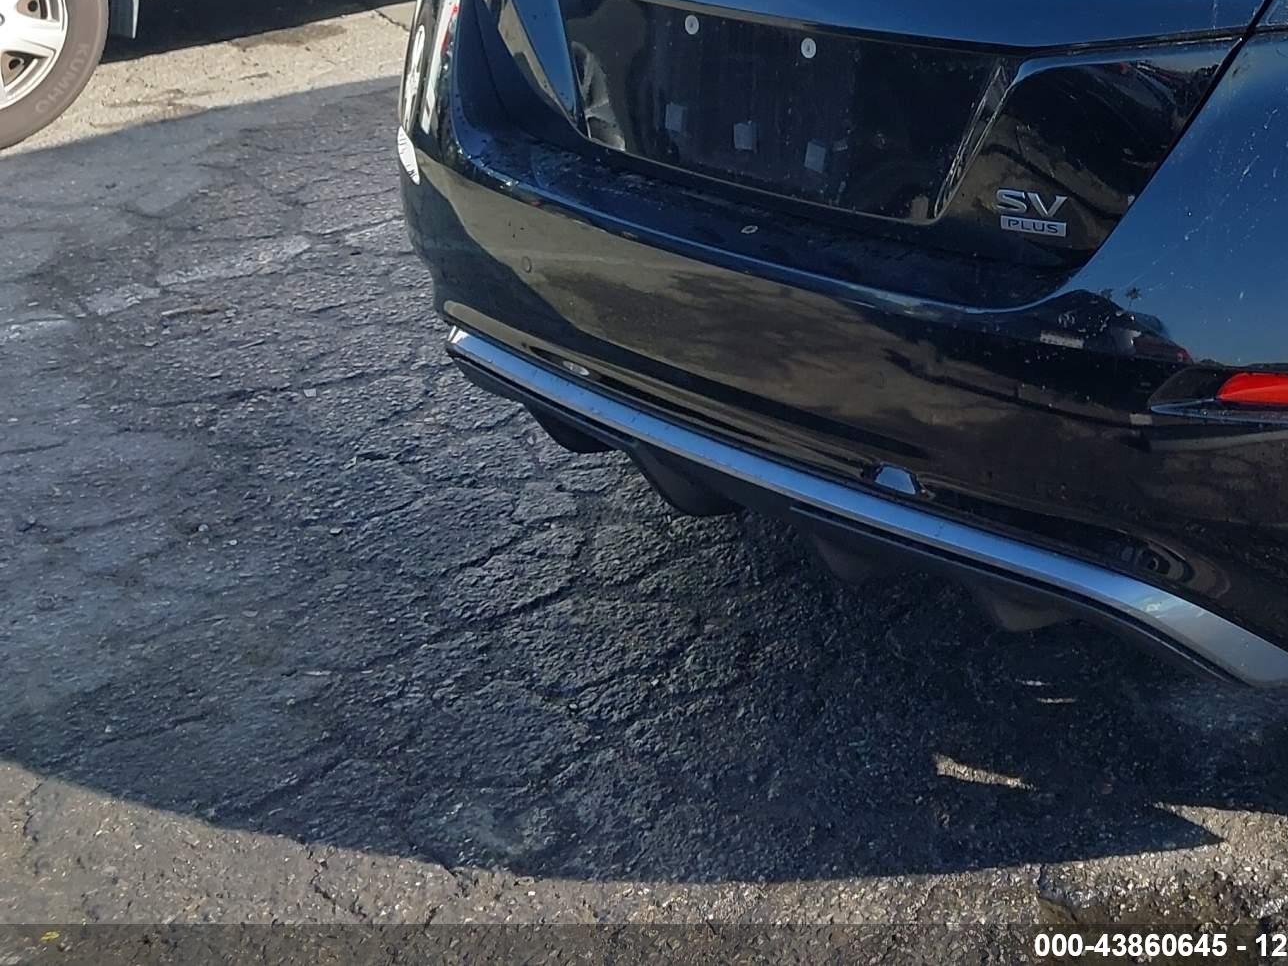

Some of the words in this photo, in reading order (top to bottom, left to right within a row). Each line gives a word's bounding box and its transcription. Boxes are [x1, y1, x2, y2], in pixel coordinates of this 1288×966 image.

[35, 43, 90, 113] KUMHO
[995, 188, 1068, 218] SV
[1007, 218, 1059, 234] PLUS
